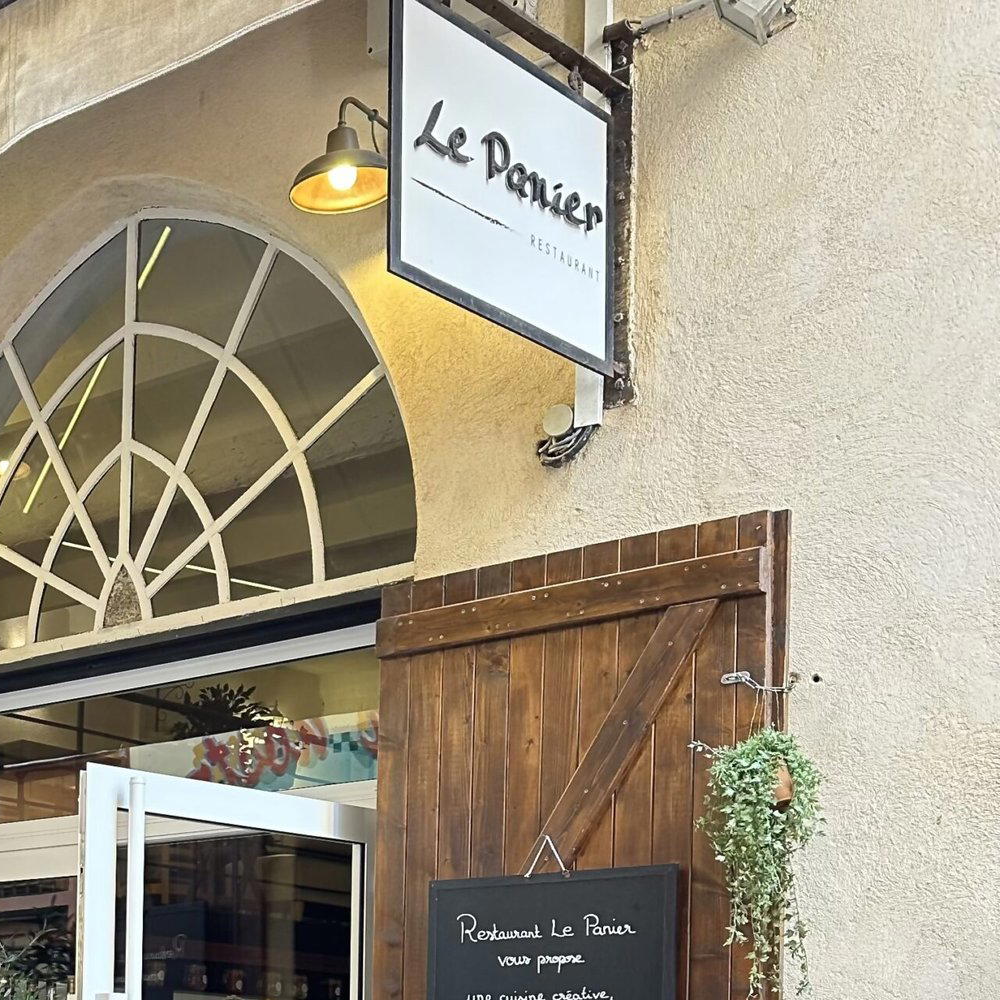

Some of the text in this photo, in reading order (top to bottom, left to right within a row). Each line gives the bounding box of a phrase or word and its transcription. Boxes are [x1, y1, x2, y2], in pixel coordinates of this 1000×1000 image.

[413, 99, 603, 233] Le Panier
[530, 234, 600, 283] RESTAURANT
[456, 913, 637, 943] Restaurant Le Panier
[498, 953, 585, 974] vous propose
